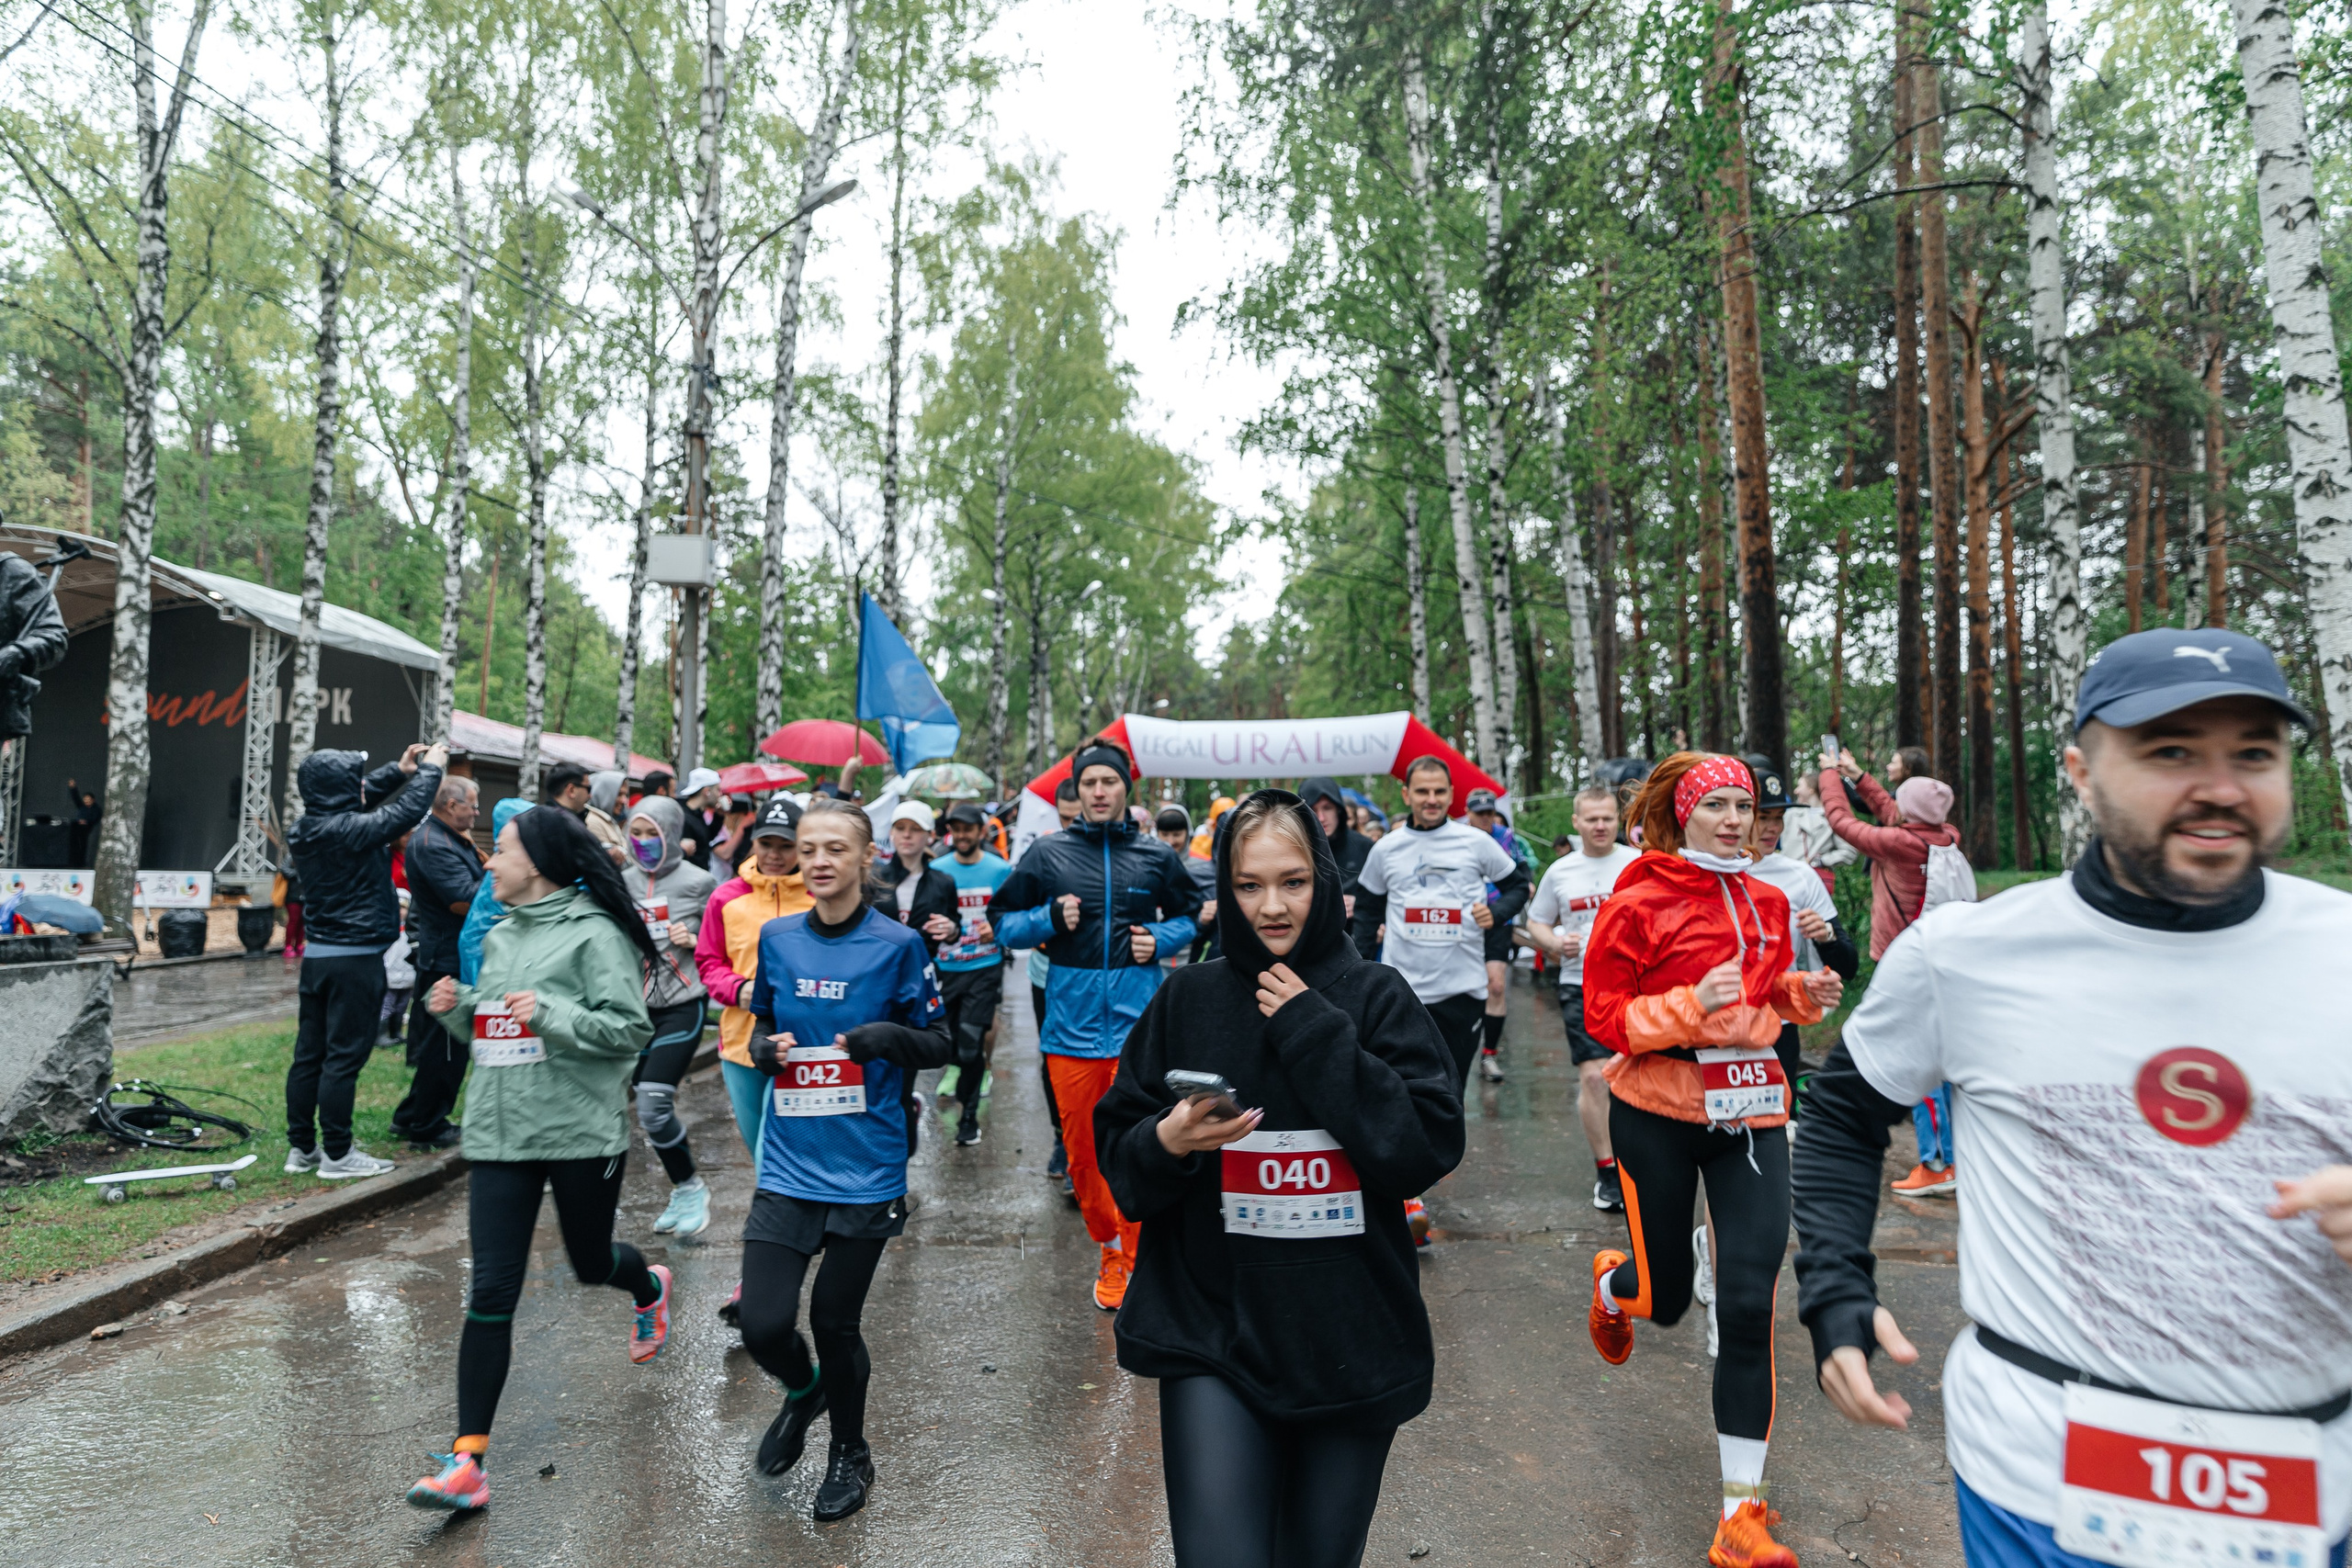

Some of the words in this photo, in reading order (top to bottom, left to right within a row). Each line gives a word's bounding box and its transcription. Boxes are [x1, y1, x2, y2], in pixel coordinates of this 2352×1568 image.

[100, 677, 249, 728] und
[1142, 736, 1207, 758] LEGAL
[1211, 731, 1333, 765] URAL
[1331, 732, 1390, 756] RUN
[1419, 908, 1450, 924] 162
[485, 1016, 523, 1039] 026
[795, 1063, 842, 1087] 042
[1726, 1061, 1769, 1088] 045
[2159, 1059, 2227, 1132] S
[1258, 1156, 1332, 1190] 040
[2138, 1445, 2269, 1516] 105
